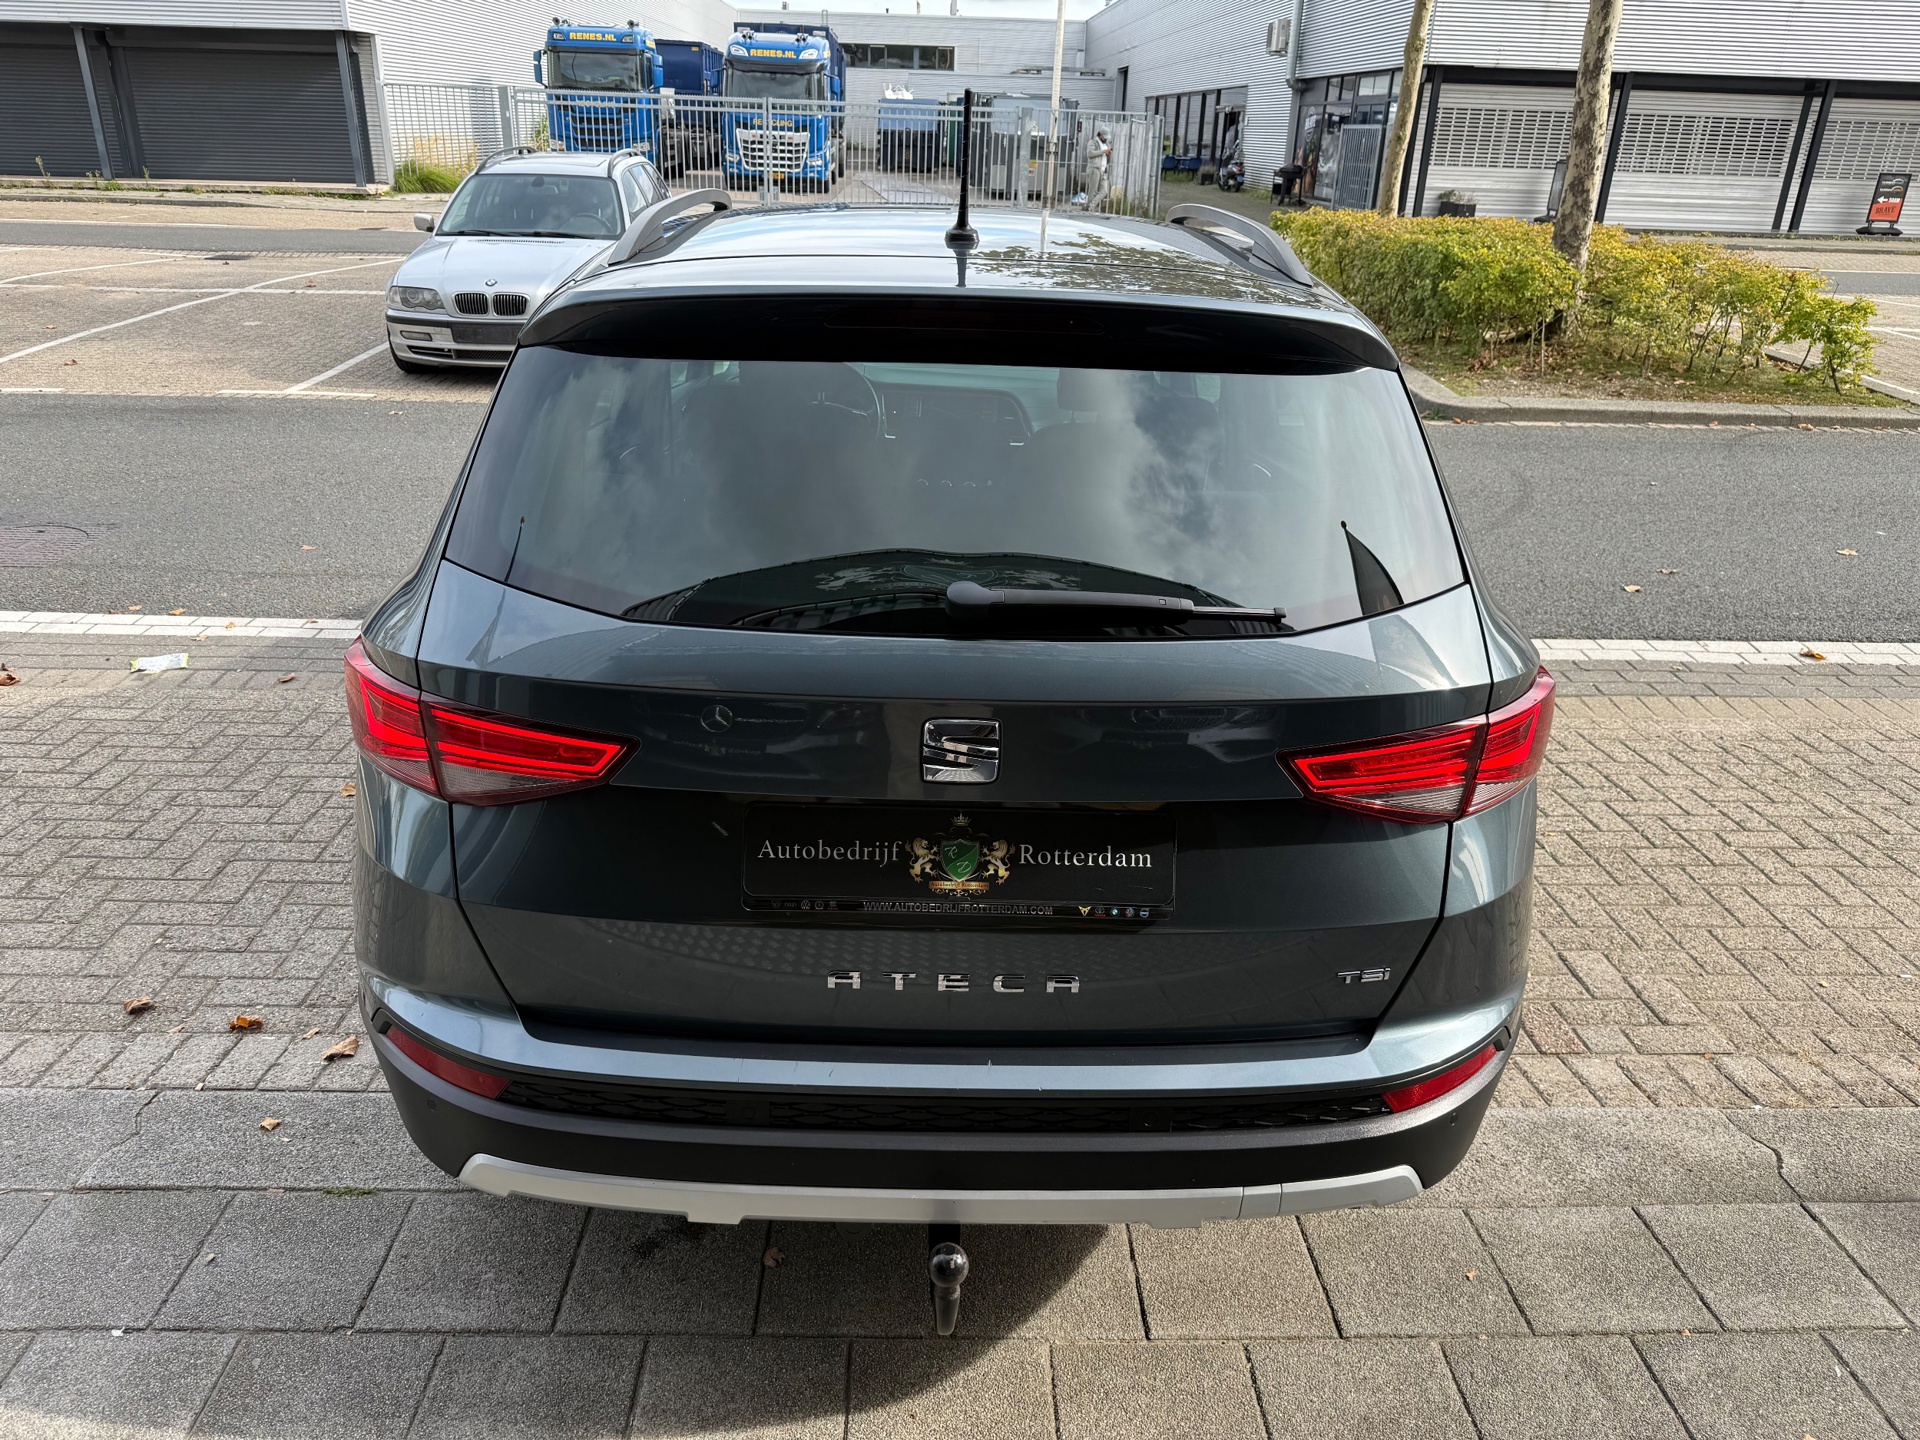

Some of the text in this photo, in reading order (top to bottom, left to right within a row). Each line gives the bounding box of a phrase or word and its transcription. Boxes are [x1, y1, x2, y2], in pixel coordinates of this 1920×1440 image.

[569, 32, 617, 42] RENES.NL
[750, 49, 797, 59] RENES.NL
[757, 839, 1152, 867] Autobedrijf Rotterdam
[863, 901, 1053, 915] WWW.AUTOBEDRIJFROTTERDAM.COM
[827, 970, 1080, 993] ATECA
